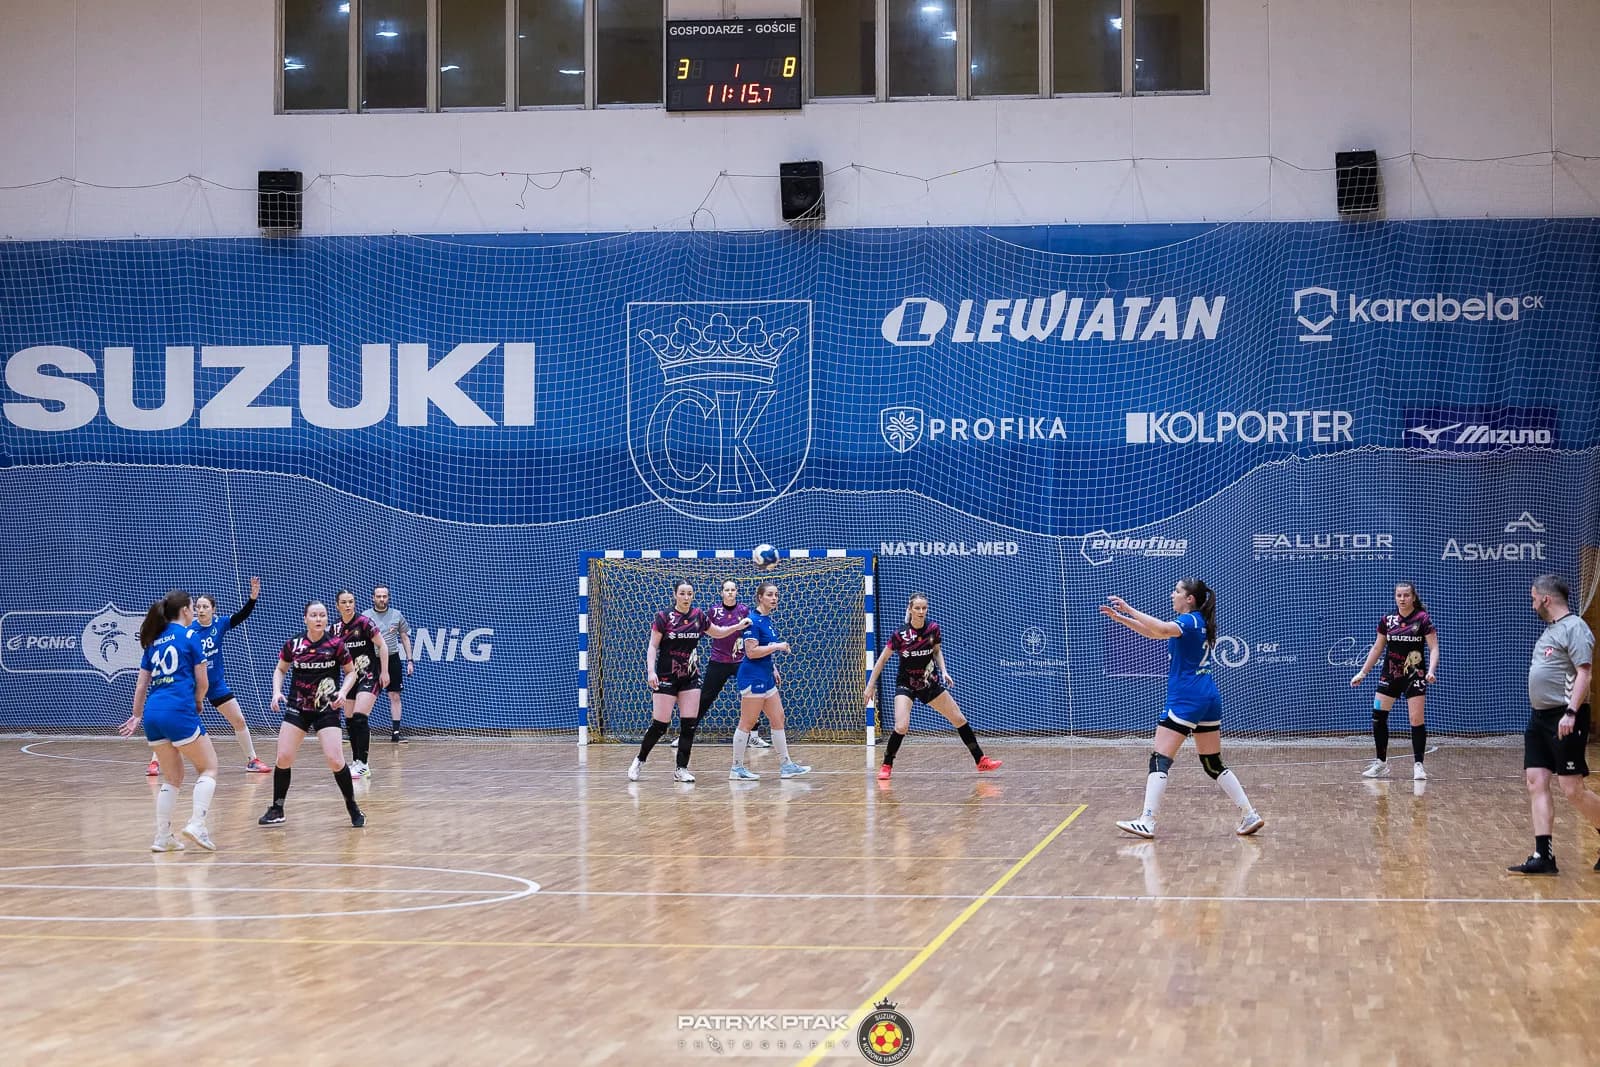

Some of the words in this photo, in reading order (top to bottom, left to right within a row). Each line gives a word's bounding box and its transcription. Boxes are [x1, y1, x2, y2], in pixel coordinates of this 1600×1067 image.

[669, 25, 744, 35] GOSPODARZE
[755, 21, 797, 33] GOŚCIE
[677, 58, 690, 79] 3
[734, 63, 740, 78] 1
[782, 56, 796, 78] 8
[951, 290, 1226, 342] LEWIATAN
[1349, 293, 1520, 322] karabela
[2, 342, 535, 431] SUZUKI
[930, 416, 1067, 440] PROFIKA
[1149, 410, 1354, 444] KOLPORTER
[647, 388, 777, 493] CK
[880, 541, 1018, 556] NATURAL-MED
[1092, 536, 1188, 550] endorfina
[1273, 533, 1393, 548] ALUTOR
[1441, 538, 1546, 560] Aswent
[27, 635, 76, 649] PGNiG
[292, 638, 307, 652] 14
[399, 627, 494, 662] NiG
